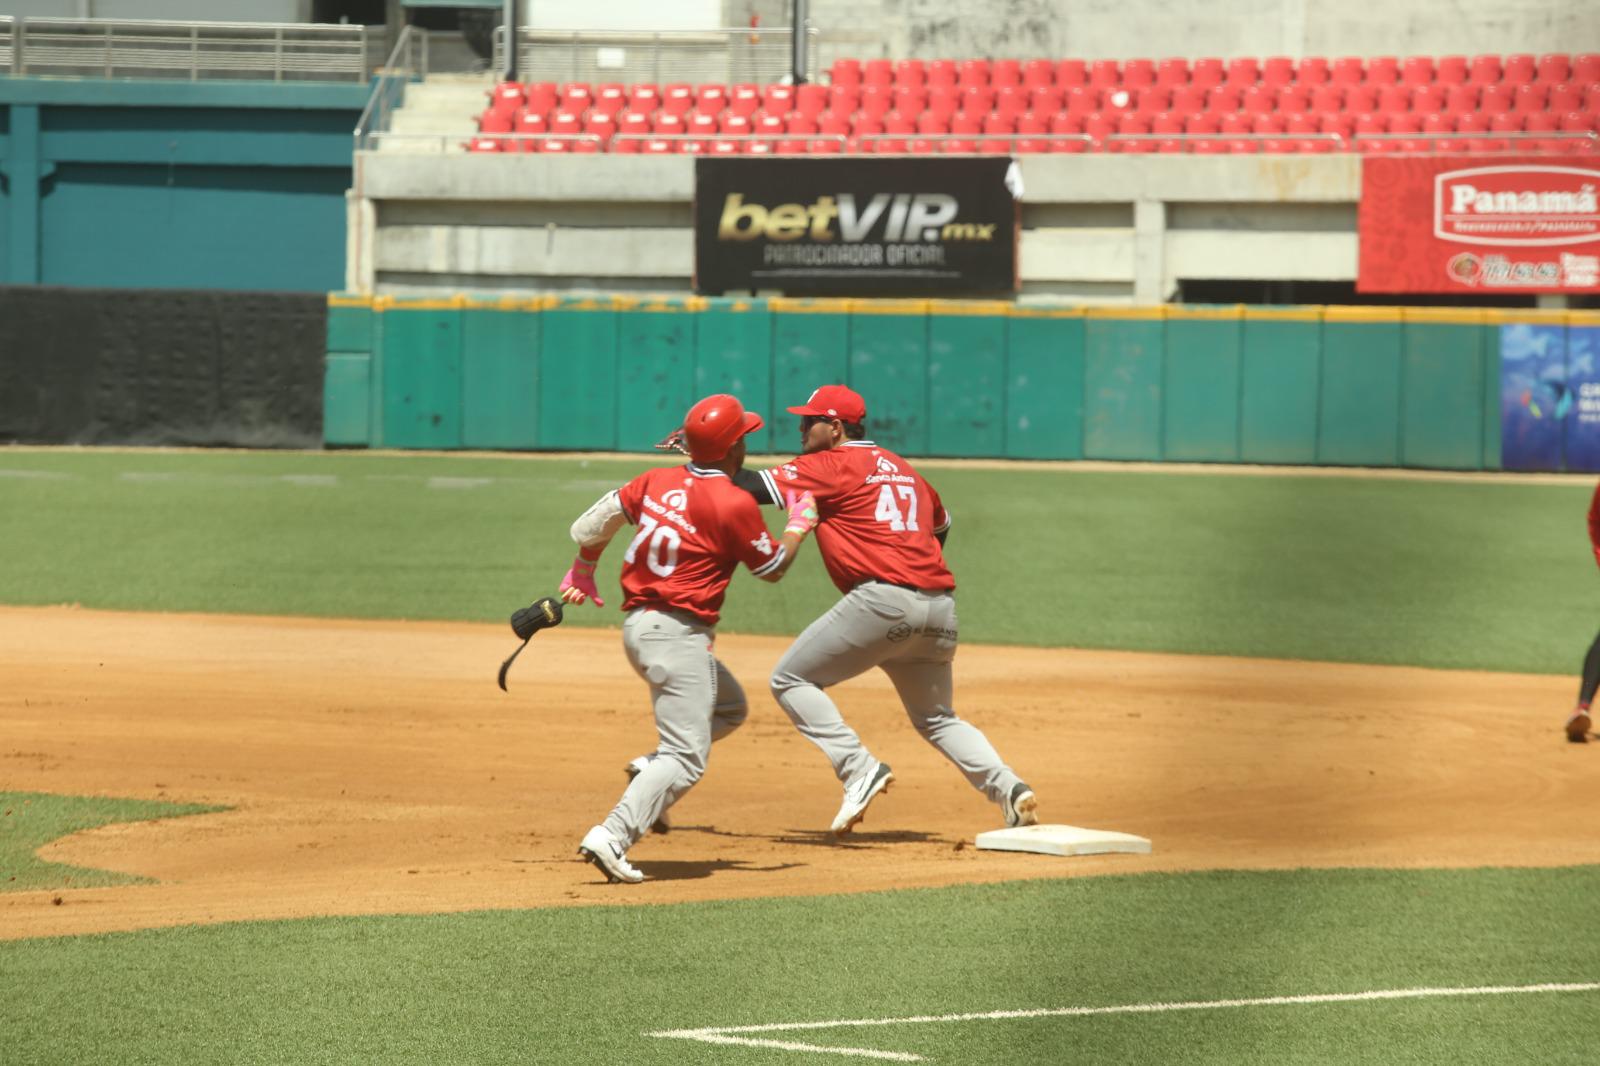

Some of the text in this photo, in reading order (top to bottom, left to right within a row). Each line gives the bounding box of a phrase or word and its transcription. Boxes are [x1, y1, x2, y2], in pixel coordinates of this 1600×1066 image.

[1450, 183, 1598, 214] Panamá
[886, 244, 946, 266] OFICIAL
[874, 484, 920, 532] 47
[624, 512, 682, 577] 70
